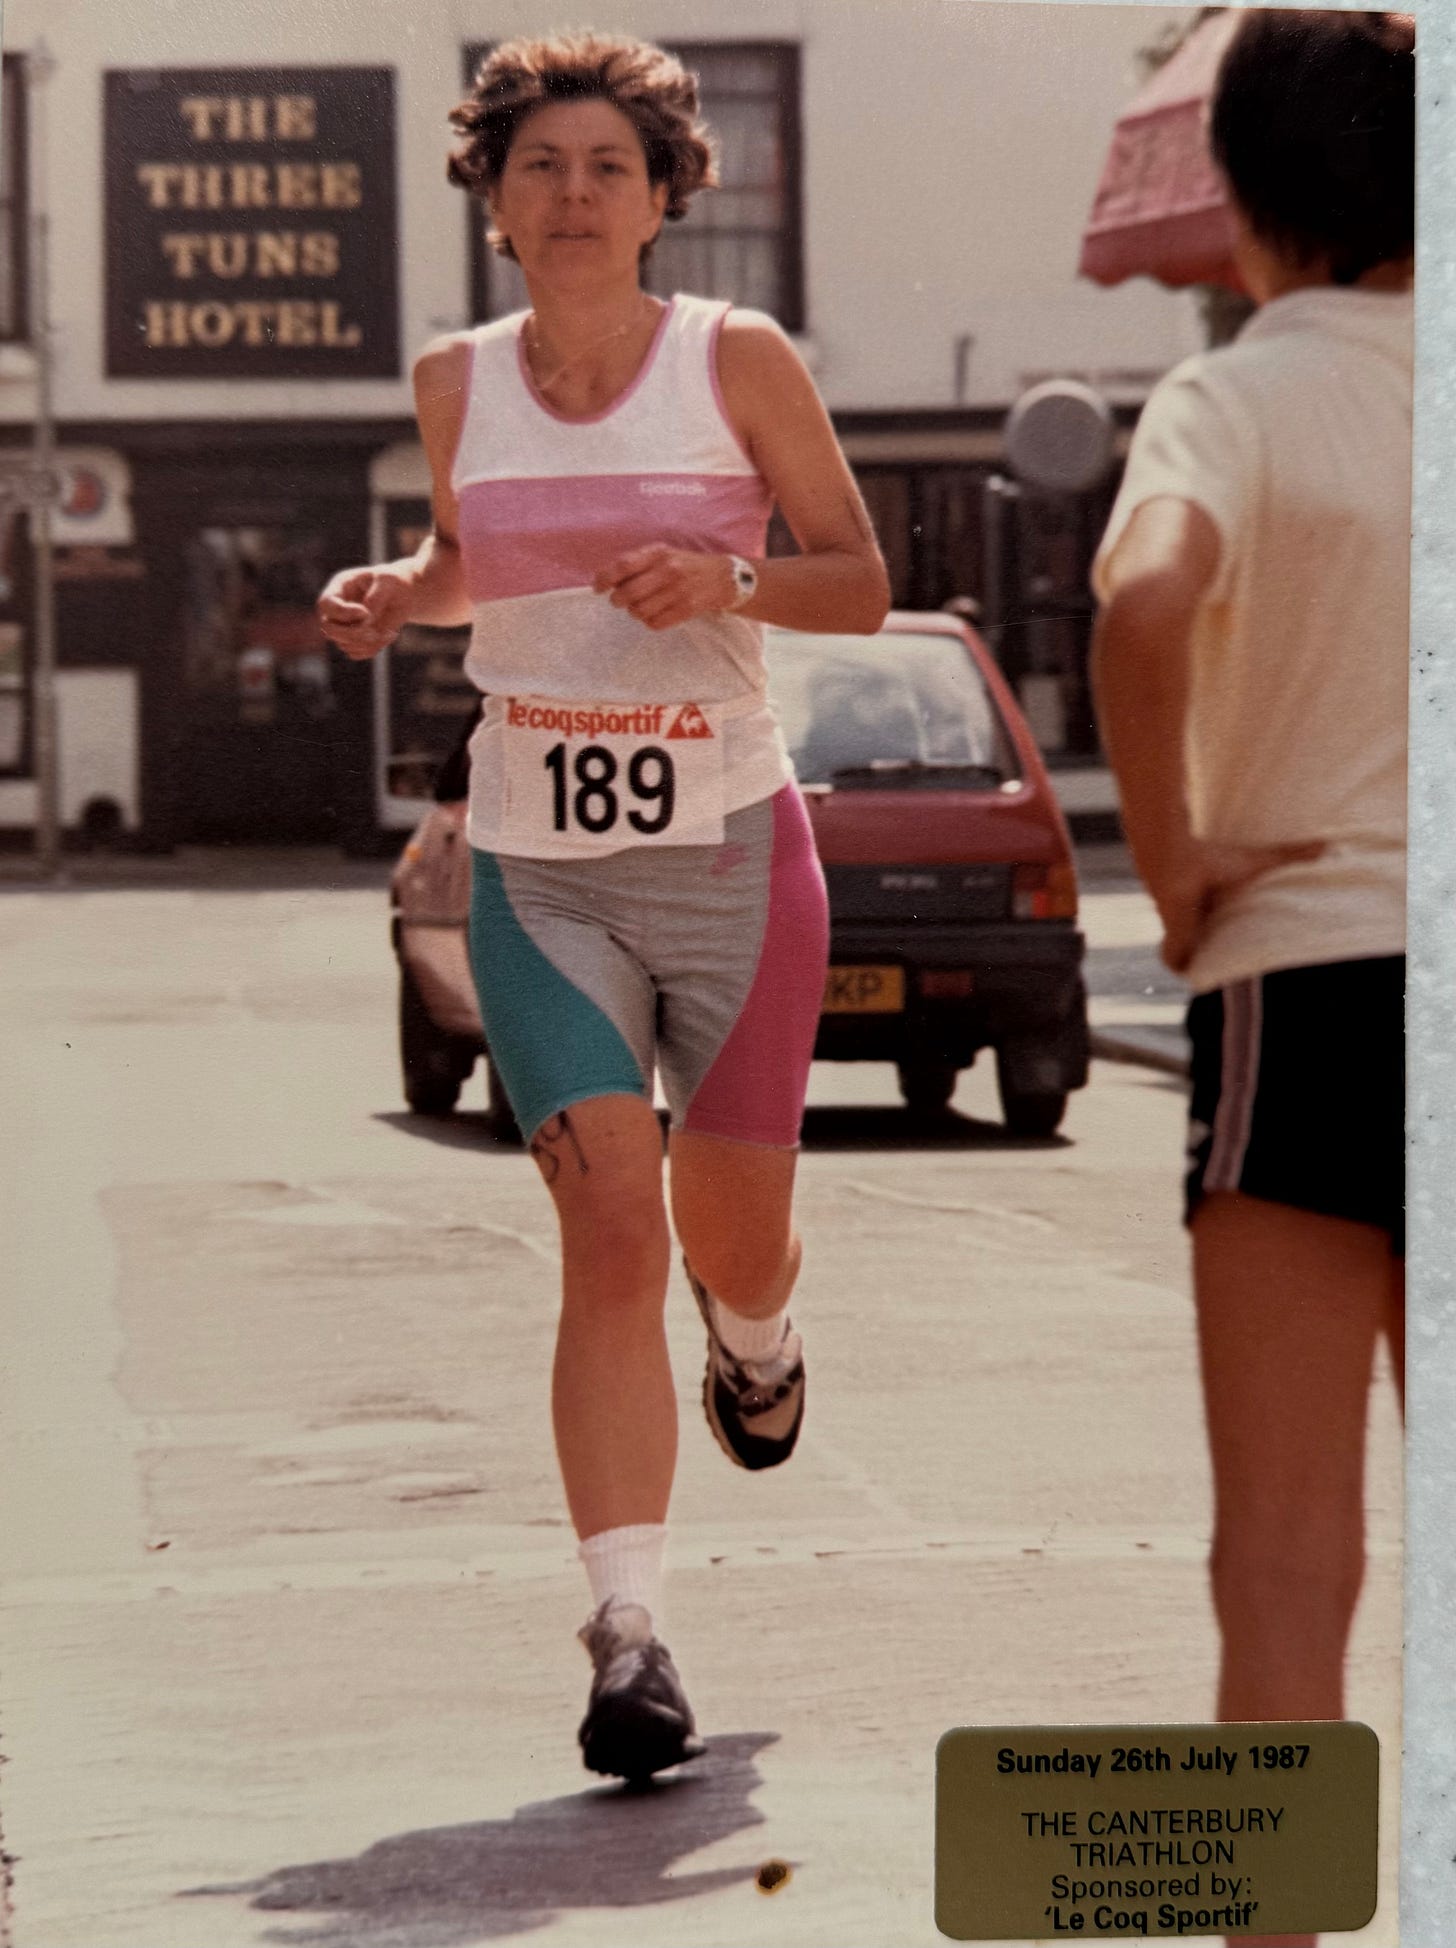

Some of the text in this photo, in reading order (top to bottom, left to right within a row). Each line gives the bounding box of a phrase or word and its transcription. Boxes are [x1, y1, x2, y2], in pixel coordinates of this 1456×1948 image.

[180, 95, 317, 142] THE
[136, 162, 361, 210] THREE
[161, 231, 340, 279] TUNS
[142, 301, 362, 348] HOTEL
[506, 697, 663, 739] lecoqsportif
[544, 742, 675, 835] 189
[996, 1744, 1311, 1778] Sunday 26th July 1987
[1021, 1807, 1284, 1836] THE CANTERBURY
[1070, 1840, 1234, 1867] TRIATHLON
[1051, 1871, 1252, 1904] Sponsored by:
[1094, 1904, 1148, 1934] Coq
